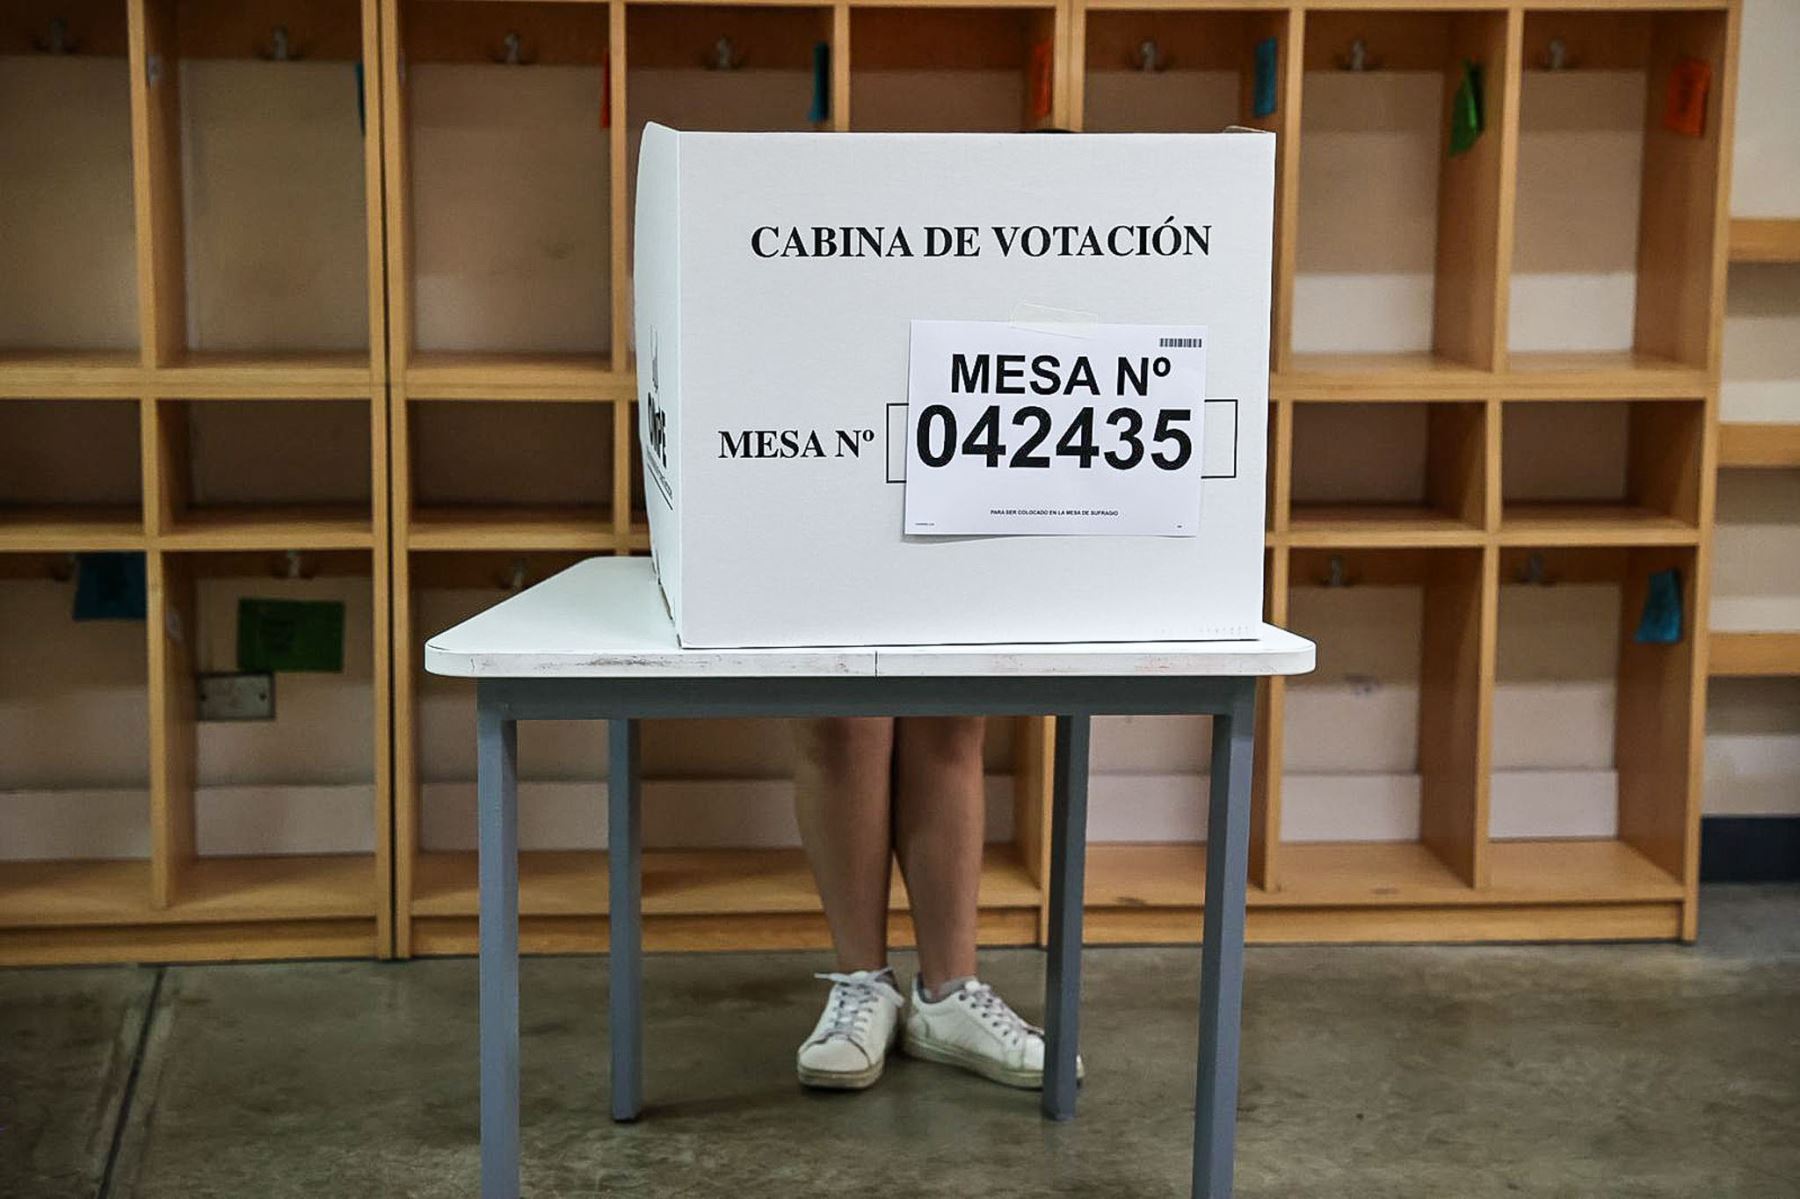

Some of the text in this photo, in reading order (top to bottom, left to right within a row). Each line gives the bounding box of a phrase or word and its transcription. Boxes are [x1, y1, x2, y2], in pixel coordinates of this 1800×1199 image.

[752, 216, 1212, 258] CABINA DE VOTACIÓN
[952, 354, 1100, 395] MESA
[718, 430, 826, 458] MESA
[917, 405, 1192, 470] 042435
